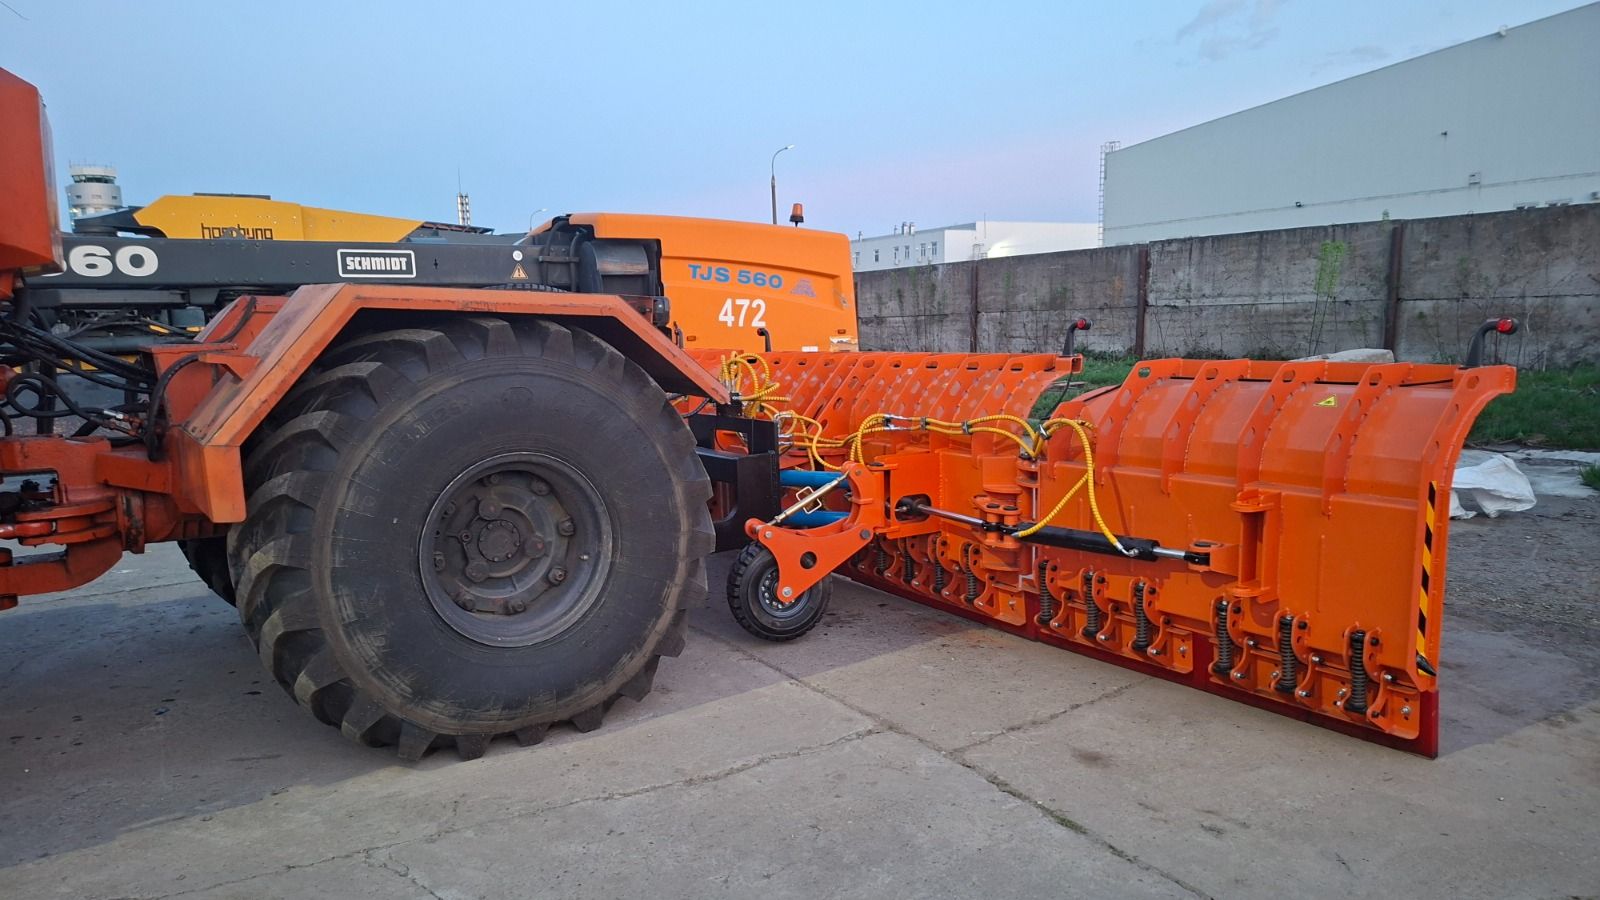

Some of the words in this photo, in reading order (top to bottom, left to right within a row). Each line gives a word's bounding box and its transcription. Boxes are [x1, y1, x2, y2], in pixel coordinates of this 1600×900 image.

[42, 245, 158, 277] 60
[346, 256, 407, 271] SCHMIDT
[688, 264, 730, 282] TJS
[737, 269, 783, 288] 560
[718, 298, 766, 327] 472
